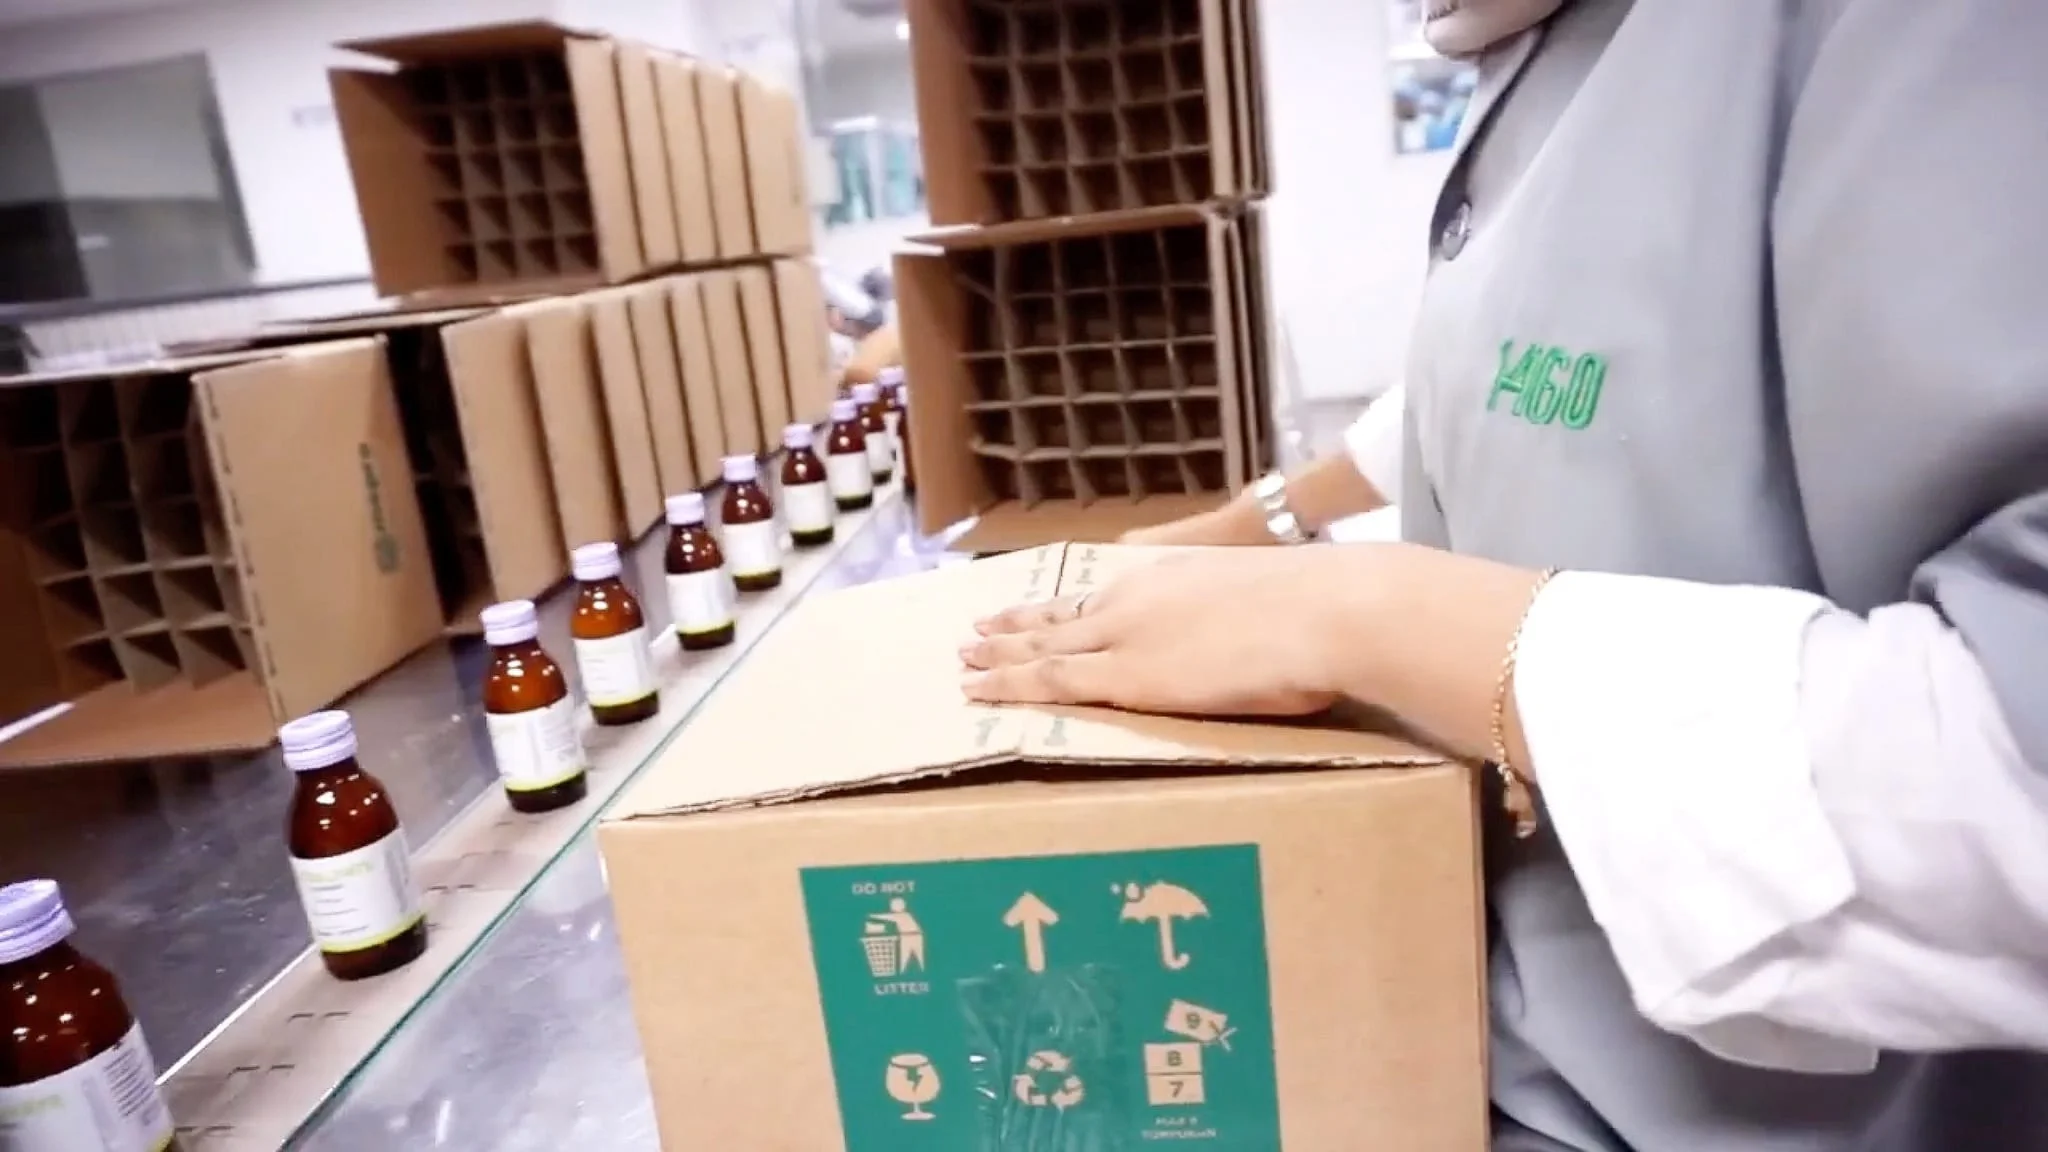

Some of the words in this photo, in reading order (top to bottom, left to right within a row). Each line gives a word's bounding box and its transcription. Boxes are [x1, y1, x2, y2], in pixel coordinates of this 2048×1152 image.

[852, 882, 877, 895] DO
[881, 880, 915, 893] NOT
[874, 982, 929, 995] LITTER
[1169, 1081, 1184, 1098] 7
